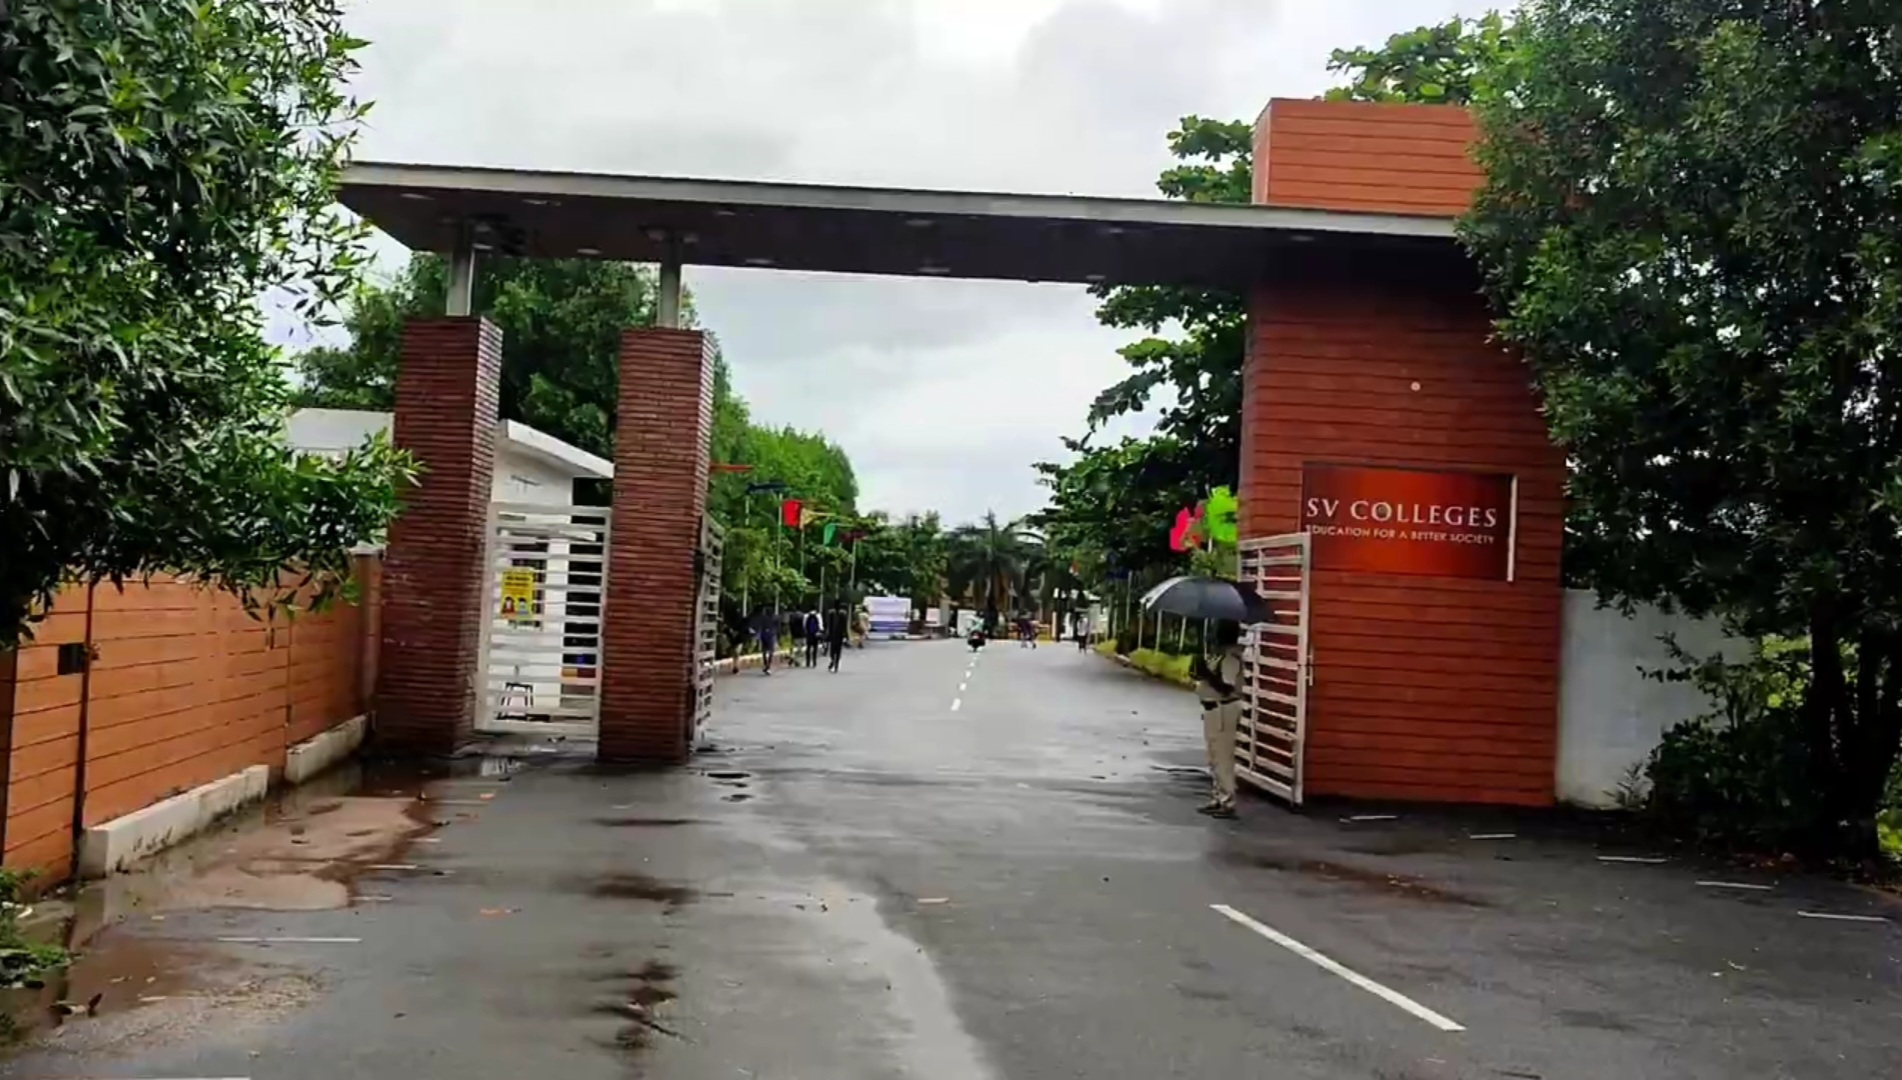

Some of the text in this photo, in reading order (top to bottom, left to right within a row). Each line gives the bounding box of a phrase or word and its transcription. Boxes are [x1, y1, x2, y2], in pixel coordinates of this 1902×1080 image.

[1306, 497, 1496, 528] SV COLLEGES
[1373, 528, 1395, 539] FOR
[1399, 531, 1408, 540] A
[1411, 531, 1447, 542] BETTER
[1450, 533, 1494, 545] SOCIETY
